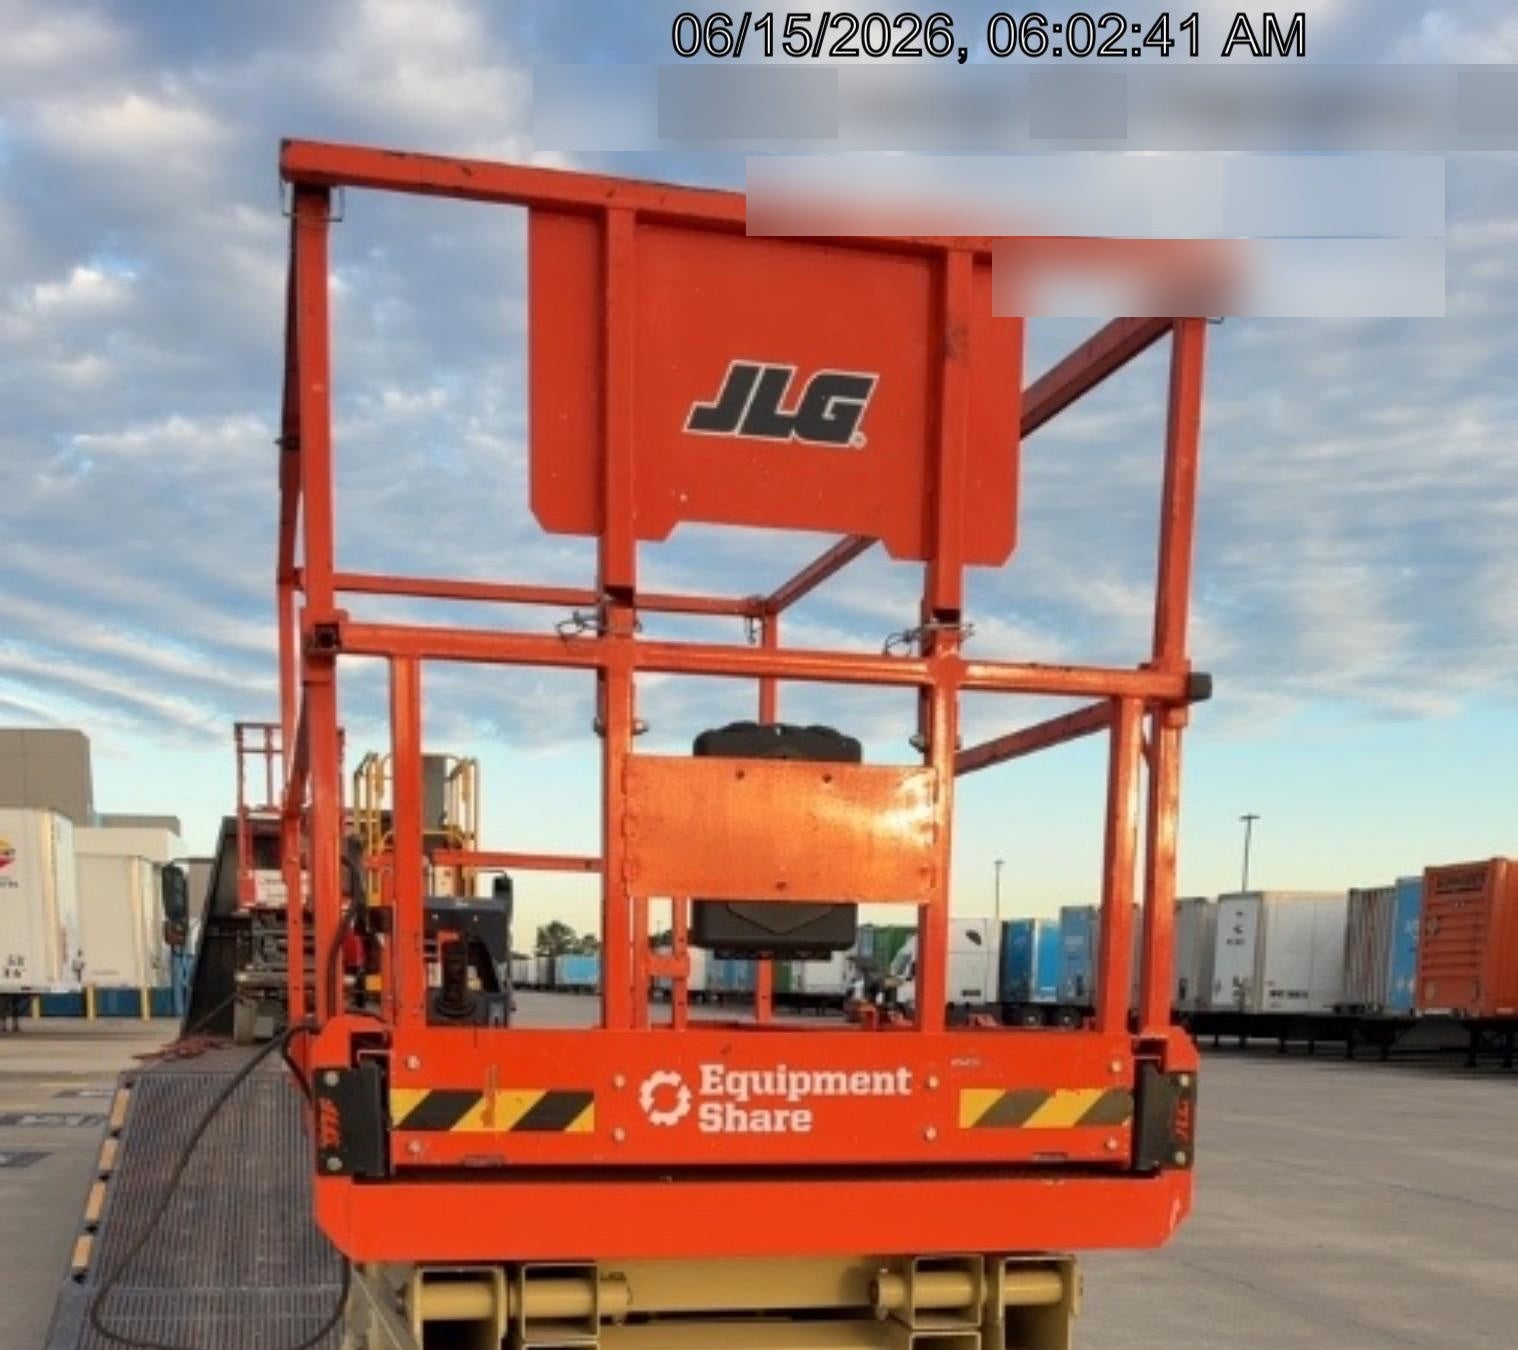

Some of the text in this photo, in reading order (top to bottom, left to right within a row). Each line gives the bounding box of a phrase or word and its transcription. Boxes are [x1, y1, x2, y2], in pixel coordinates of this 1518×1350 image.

[682, 359, 880, 449] JLG
[699, 1063, 912, 1101] Equipment
[699, 1103, 813, 1132] Share
